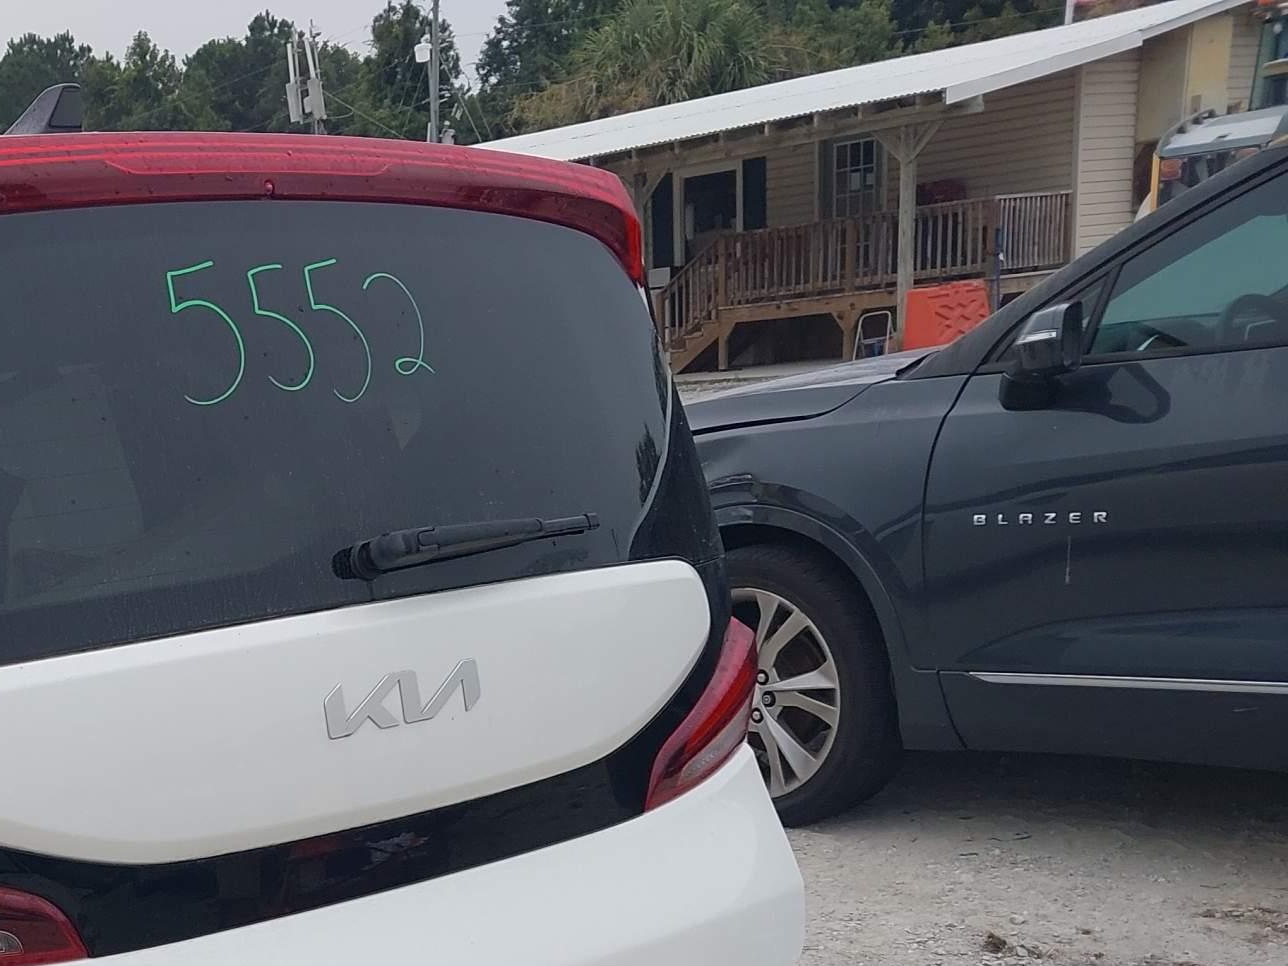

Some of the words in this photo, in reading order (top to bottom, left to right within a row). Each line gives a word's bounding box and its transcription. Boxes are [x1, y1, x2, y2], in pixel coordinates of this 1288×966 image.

[167, 258, 435, 405] 5552
[973, 511, 1107, 526] BLAZER
[323, 657, 481, 740] KIA
